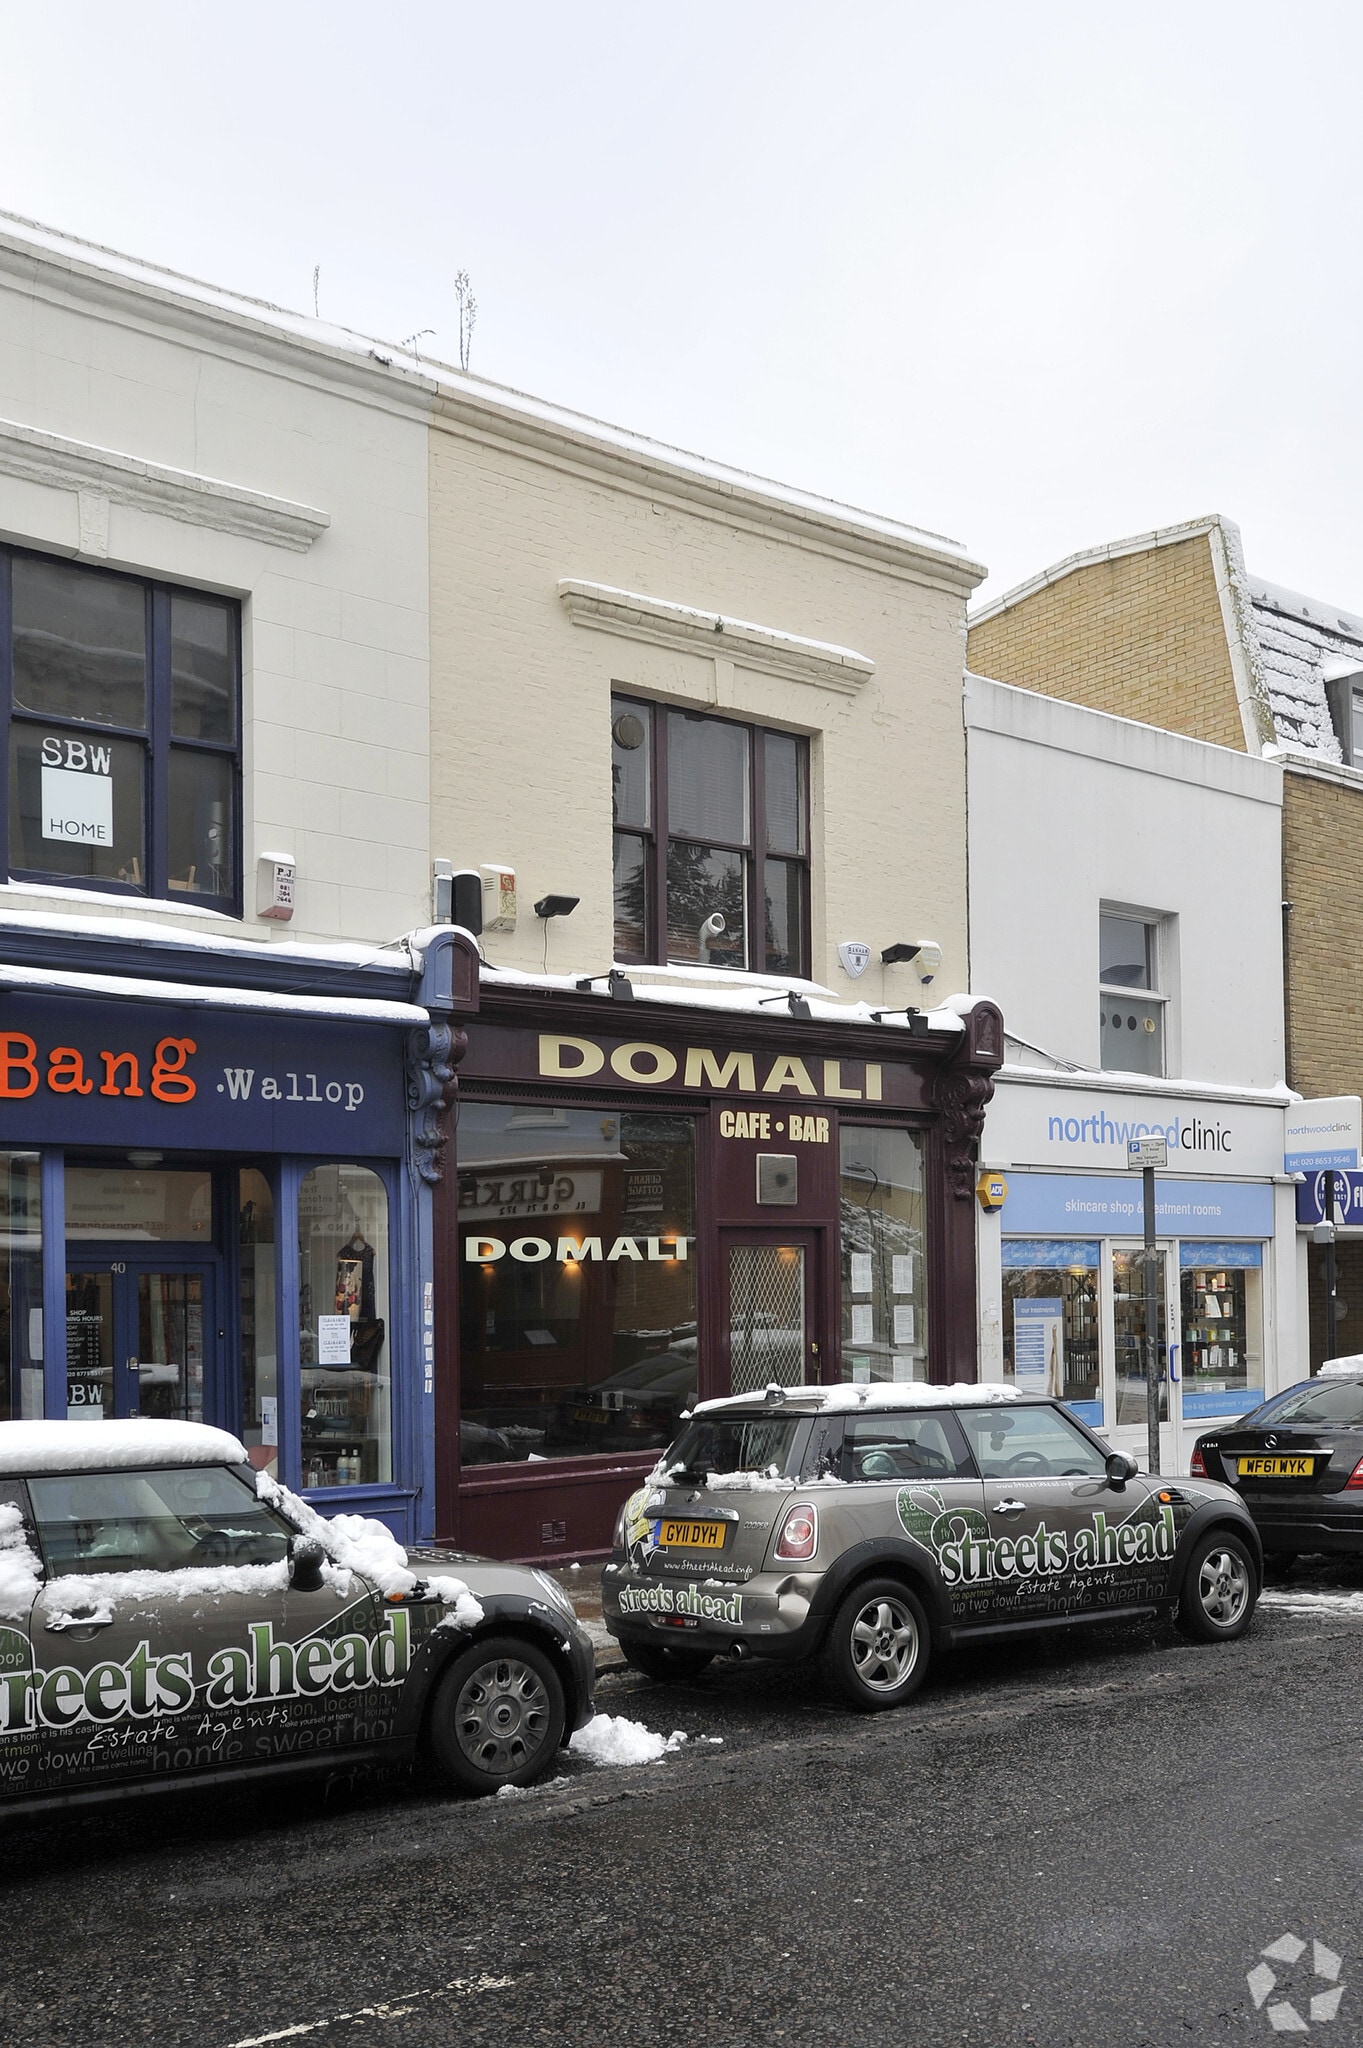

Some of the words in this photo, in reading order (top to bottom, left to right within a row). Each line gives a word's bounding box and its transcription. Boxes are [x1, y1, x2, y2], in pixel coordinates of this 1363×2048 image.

[41, 737, 112, 775] SBW
[49, 818, 106, 840] HOME
[0, 1031, 197, 1103] Bang
[223, 1067, 365, 1111] Wallop
[538, 1034, 882, 1101] DOMALI
[719, 1110, 770, 1141] CAFE
[788, 1114, 830, 1144] BAR
[1287, 1122, 1352, 1136] northwoodclinic
[1301, 1158, 1314, 1166] 020
[990, 1184, 1004, 1196] ADT
[1064, 1198, 1108, 1213] skincare
[1110, 1200, 1135, 1216] shop
[1154, 1203, 1191, 1216] eatment
[1192, 1204, 1222, 1216] rooms
[465, 1236, 688, 1263] DOMALI
[110, 1262, 126, 1274] 40
[67, 1384, 104, 1405] BW
[1246, 1460, 1276, 1473] WF61
[1280, 1460, 1306, 1473] WYK
[666, 1524, 690, 1543] GY11
[691, 1525, 718, 1544] DYH
[743, 1522, 770, 1530] COOPER
[940, 1521, 1070, 1586] streets
[1074, 1505, 1176, 1571] ahead
[1016, 1578, 1061, 1596] Estate
[1069, 1570, 1115, 1600] Agents
[1097, 1582, 1141, 1606] sweet
[618, 1583, 674, 1614] streets
[676, 1584, 744, 1626] ahead
[952, 1602, 966, 1615] up
[969, 1599, 989, 1611] two
[992, 1594, 1020, 1608] down
[207, 1608, 411, 1707] ahead
[216, 1708, 233, 1717] heart
[324, 1690, 392, 1713] location,
[86, 1720, 179, 1750] Estate
[197, 1706, 288, 1751] Agents
[300, 1714, 326, 1728] yourself
[336, 1712, 354, 1720] home
[50, 1728, 58, 1738] is
[60, 1728, 74, 1736] his
[152, 1740, 243, 1770] home
[256, 1720, 344, 1758] sweet
[354, 1716, 394, 1741] ho
[38, 1750, 95, 1771] down
[102, 1744, 153, 1761] dwelling
[110, 1761, 128, 1769] come
[130, 1758, 148, 1766] home
